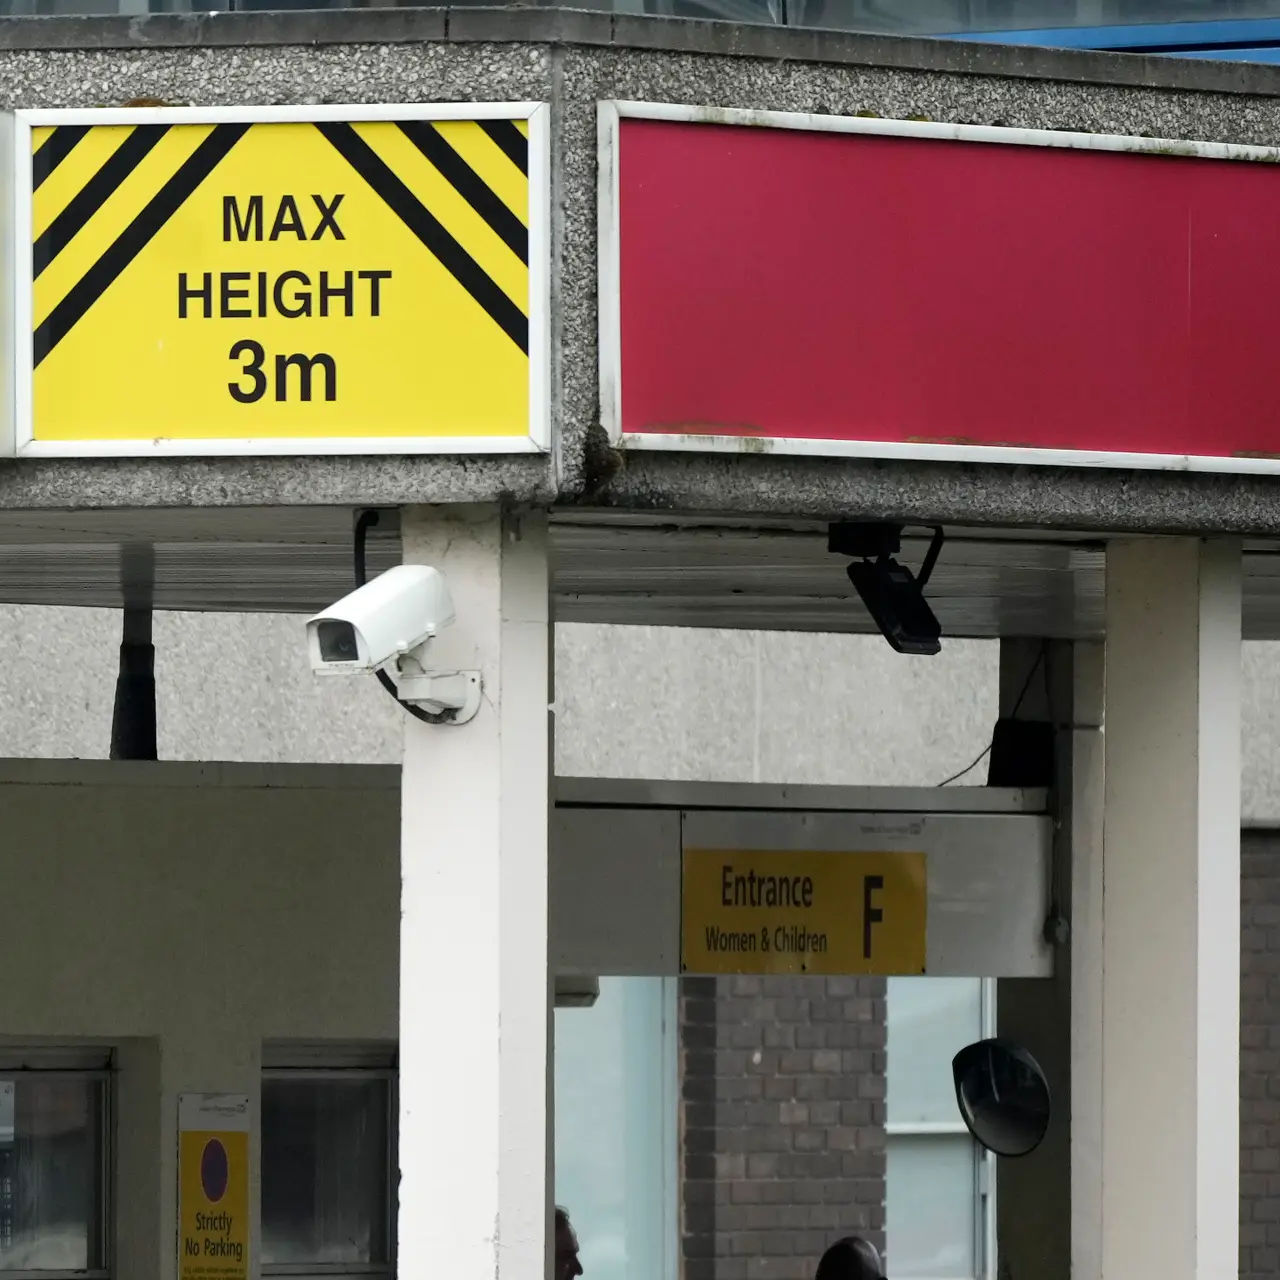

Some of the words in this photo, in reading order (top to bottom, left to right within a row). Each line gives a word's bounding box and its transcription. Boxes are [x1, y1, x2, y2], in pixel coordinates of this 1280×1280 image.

[223, 195, 345, 241] MAX
[179, 271, 391, 318] HEIGHT
[229, 340, 335, 403] 3m
[721, 865, 813, 907] Entrance
[863, 875, 883, 959] F
[705, 926, 756, 953] Women
[760, 928, 770, 951] &
[774, 926, 827, 953] Children
[195, 1210, 232, 1235] Strictly
[185, 1238, 200, 1257] No
[204, 1237, 243, 1262] Parking
